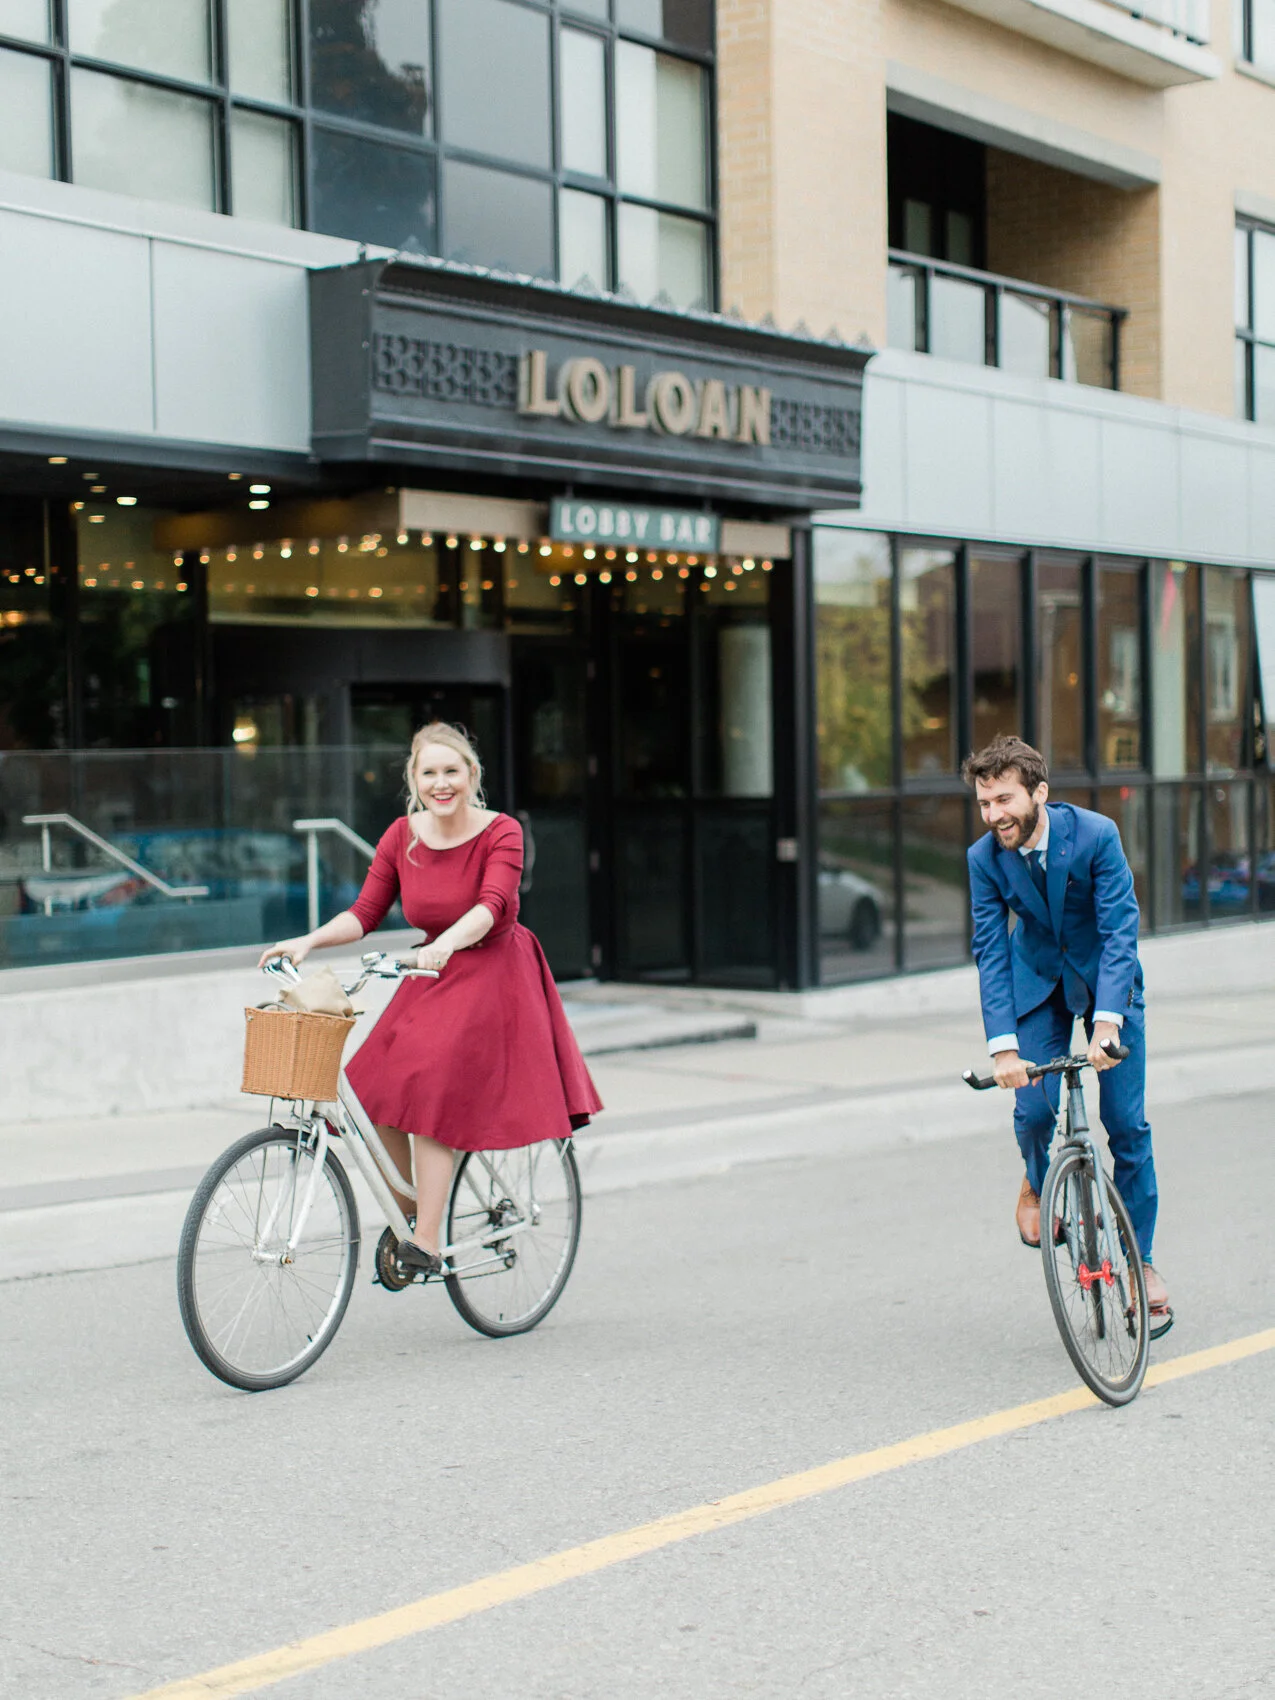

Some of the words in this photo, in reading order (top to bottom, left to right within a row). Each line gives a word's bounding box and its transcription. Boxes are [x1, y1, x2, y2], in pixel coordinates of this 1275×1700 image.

[518, 350, 771, 445] LOLOAN
[561, 504, 650, 539] LOBBY
[660, 512, 712, 543] BAR
